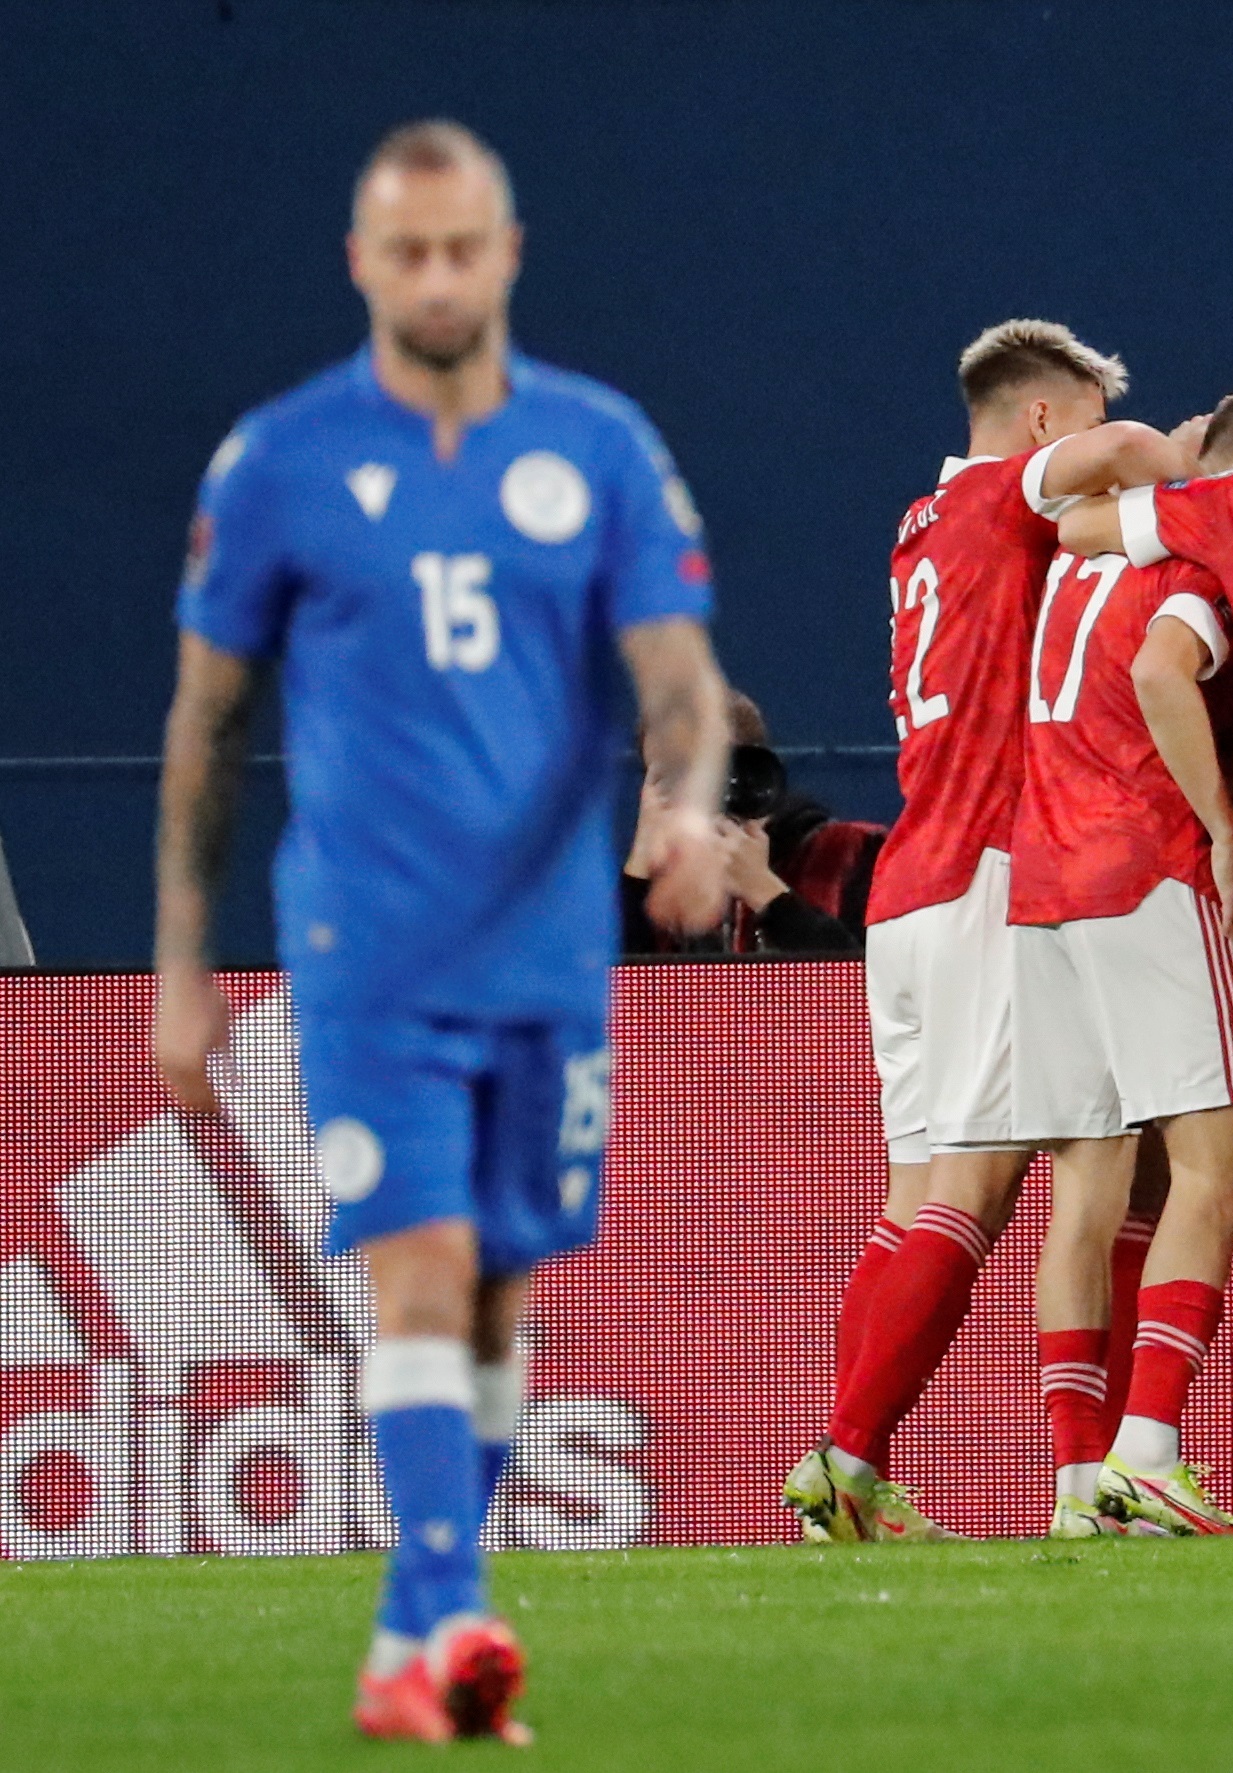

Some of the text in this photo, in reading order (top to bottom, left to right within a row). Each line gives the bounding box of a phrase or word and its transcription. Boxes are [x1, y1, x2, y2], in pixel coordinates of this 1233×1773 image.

[411, 550, 499, 673] 15
[888, 557, 950, 742] 2
[1028, 551, 1129, 724] 17
[557, 1050, 611, 1157] 15
[0, 1357, 651, 1557] dids
